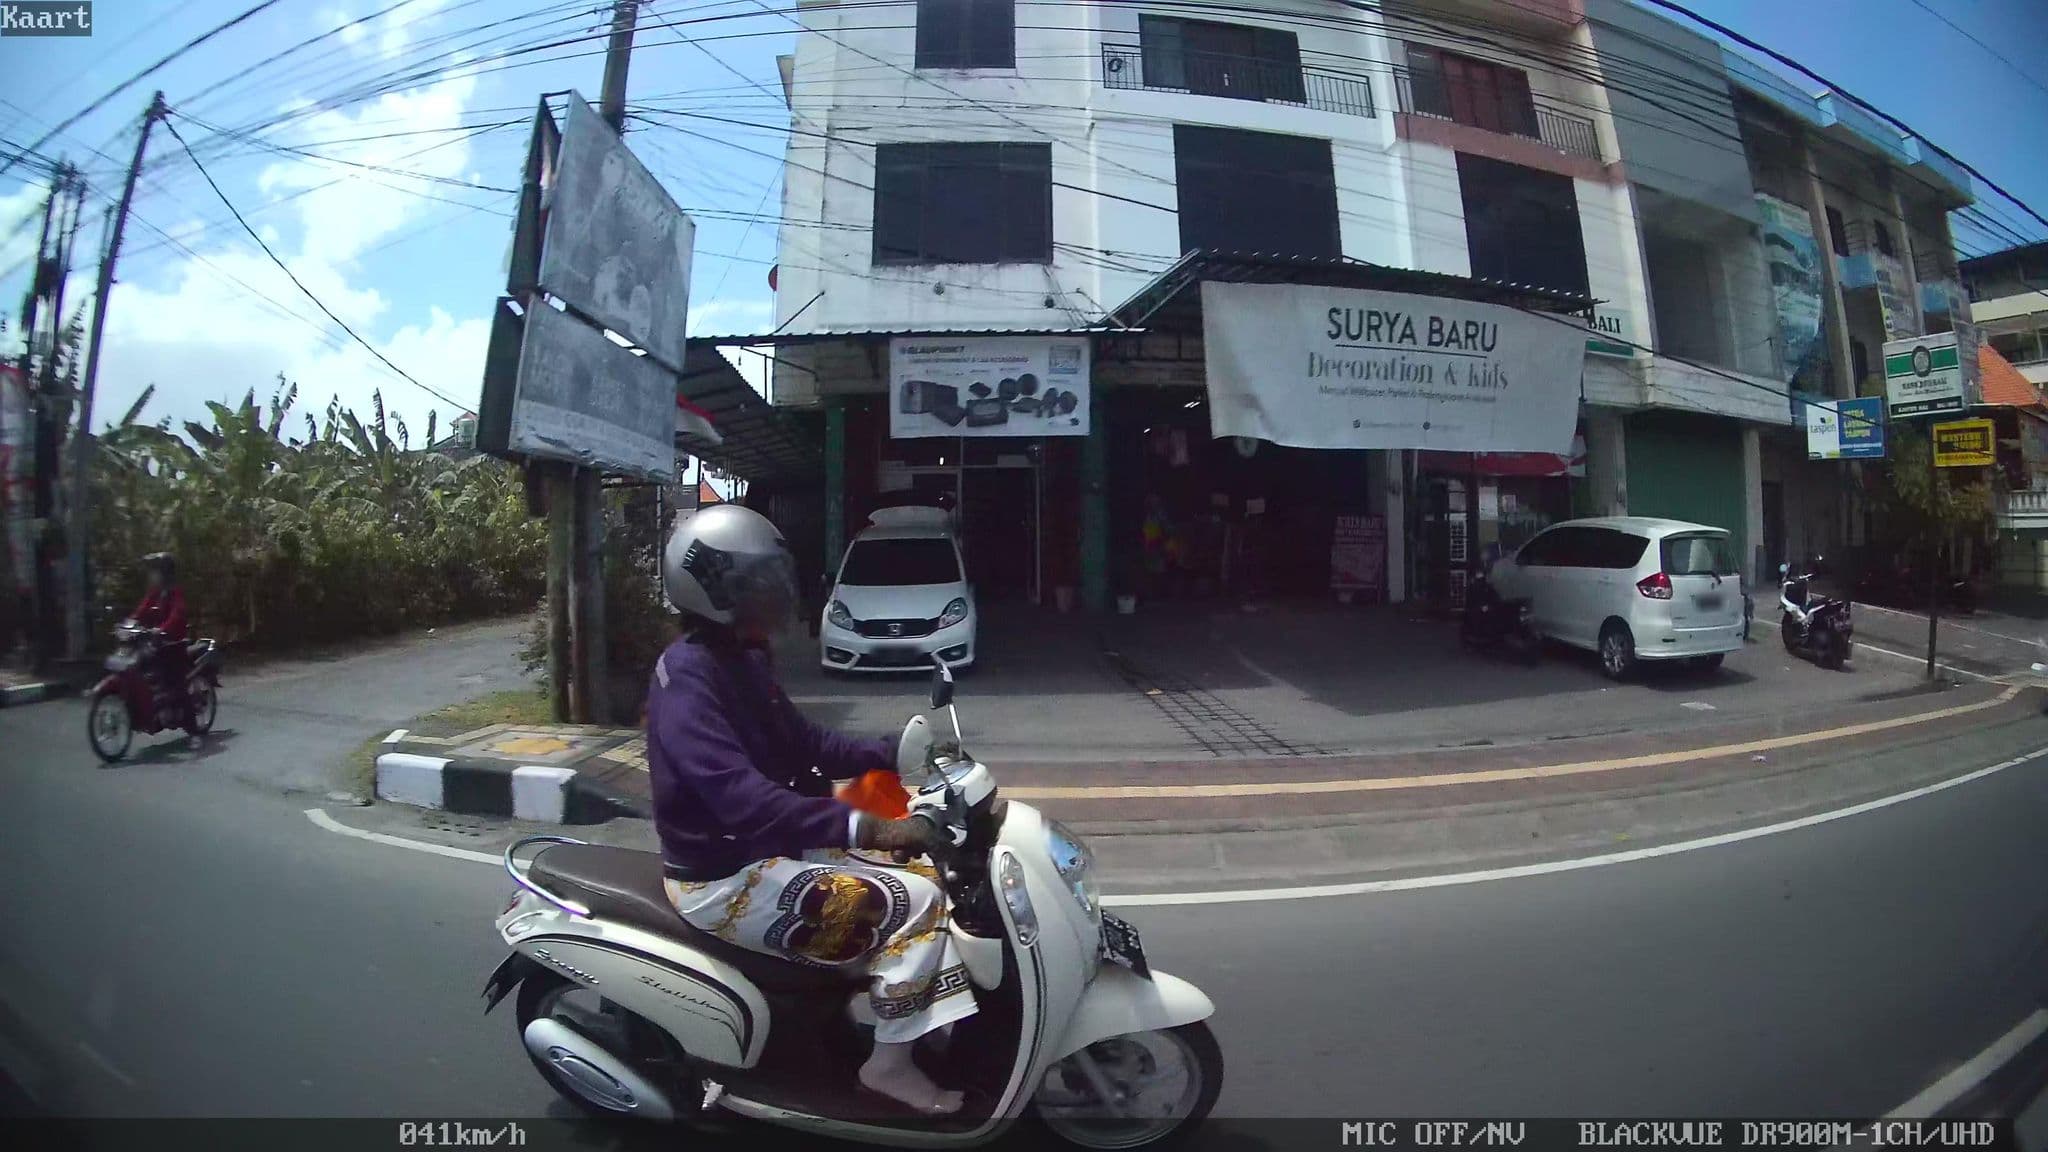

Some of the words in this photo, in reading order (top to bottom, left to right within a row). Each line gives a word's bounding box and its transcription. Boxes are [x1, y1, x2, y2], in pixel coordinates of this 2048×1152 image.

[1327, 307, 1418, 345] SURYA
[1427, 316, 1498, 352] BARU
[1307, 351, 1434, 383] Decoration
[1445, 361, 1457, 385] &
